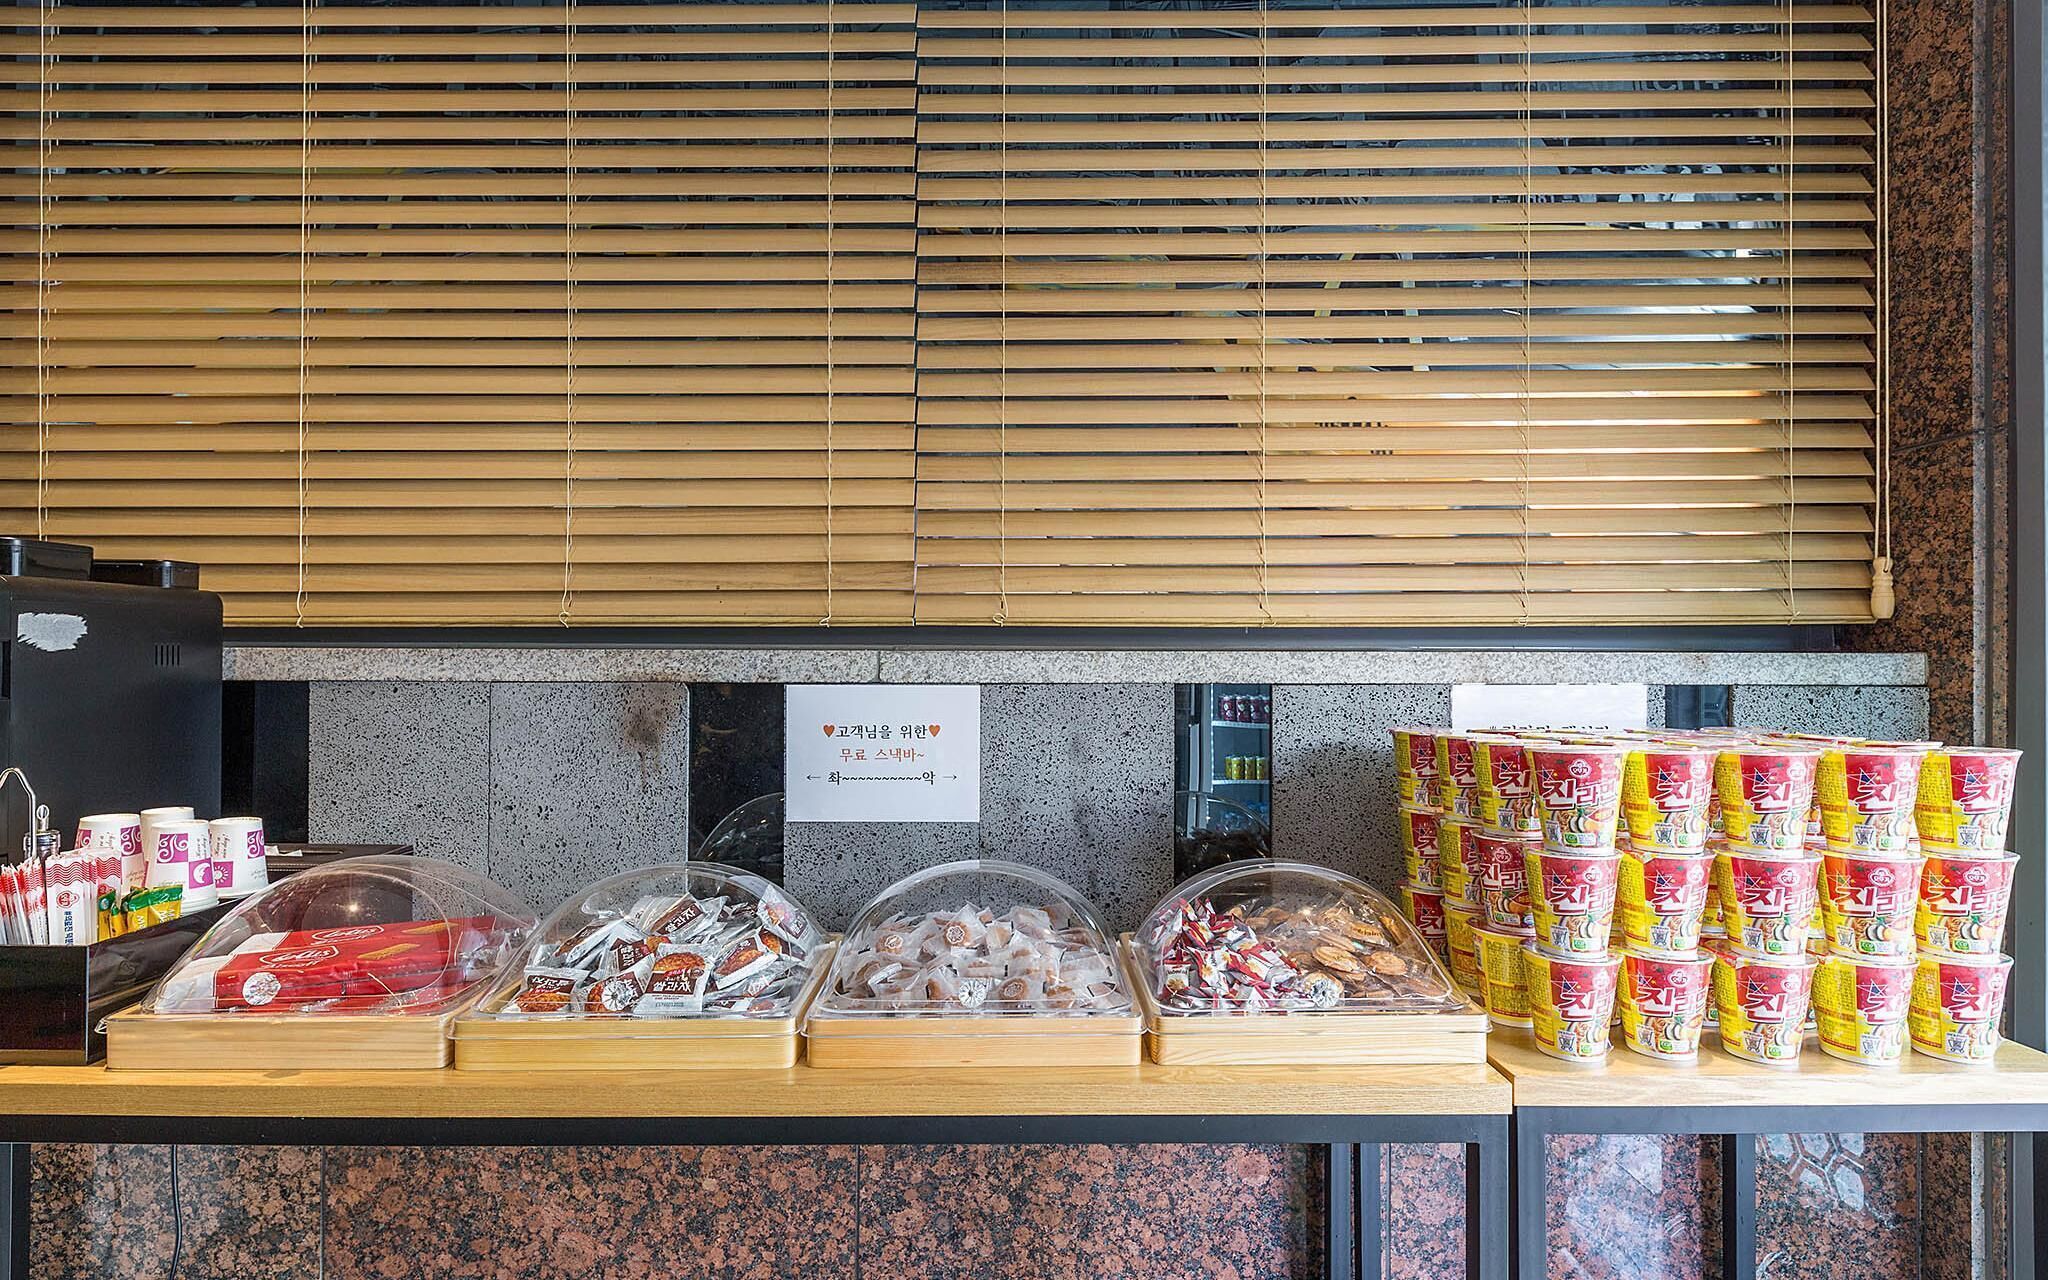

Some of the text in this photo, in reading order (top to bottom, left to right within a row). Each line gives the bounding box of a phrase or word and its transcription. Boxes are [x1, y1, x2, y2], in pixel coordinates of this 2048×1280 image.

[836, 724, 928, 740] 고객님을 위한
[840, 747, 925, 762] 무료 스낵바~
